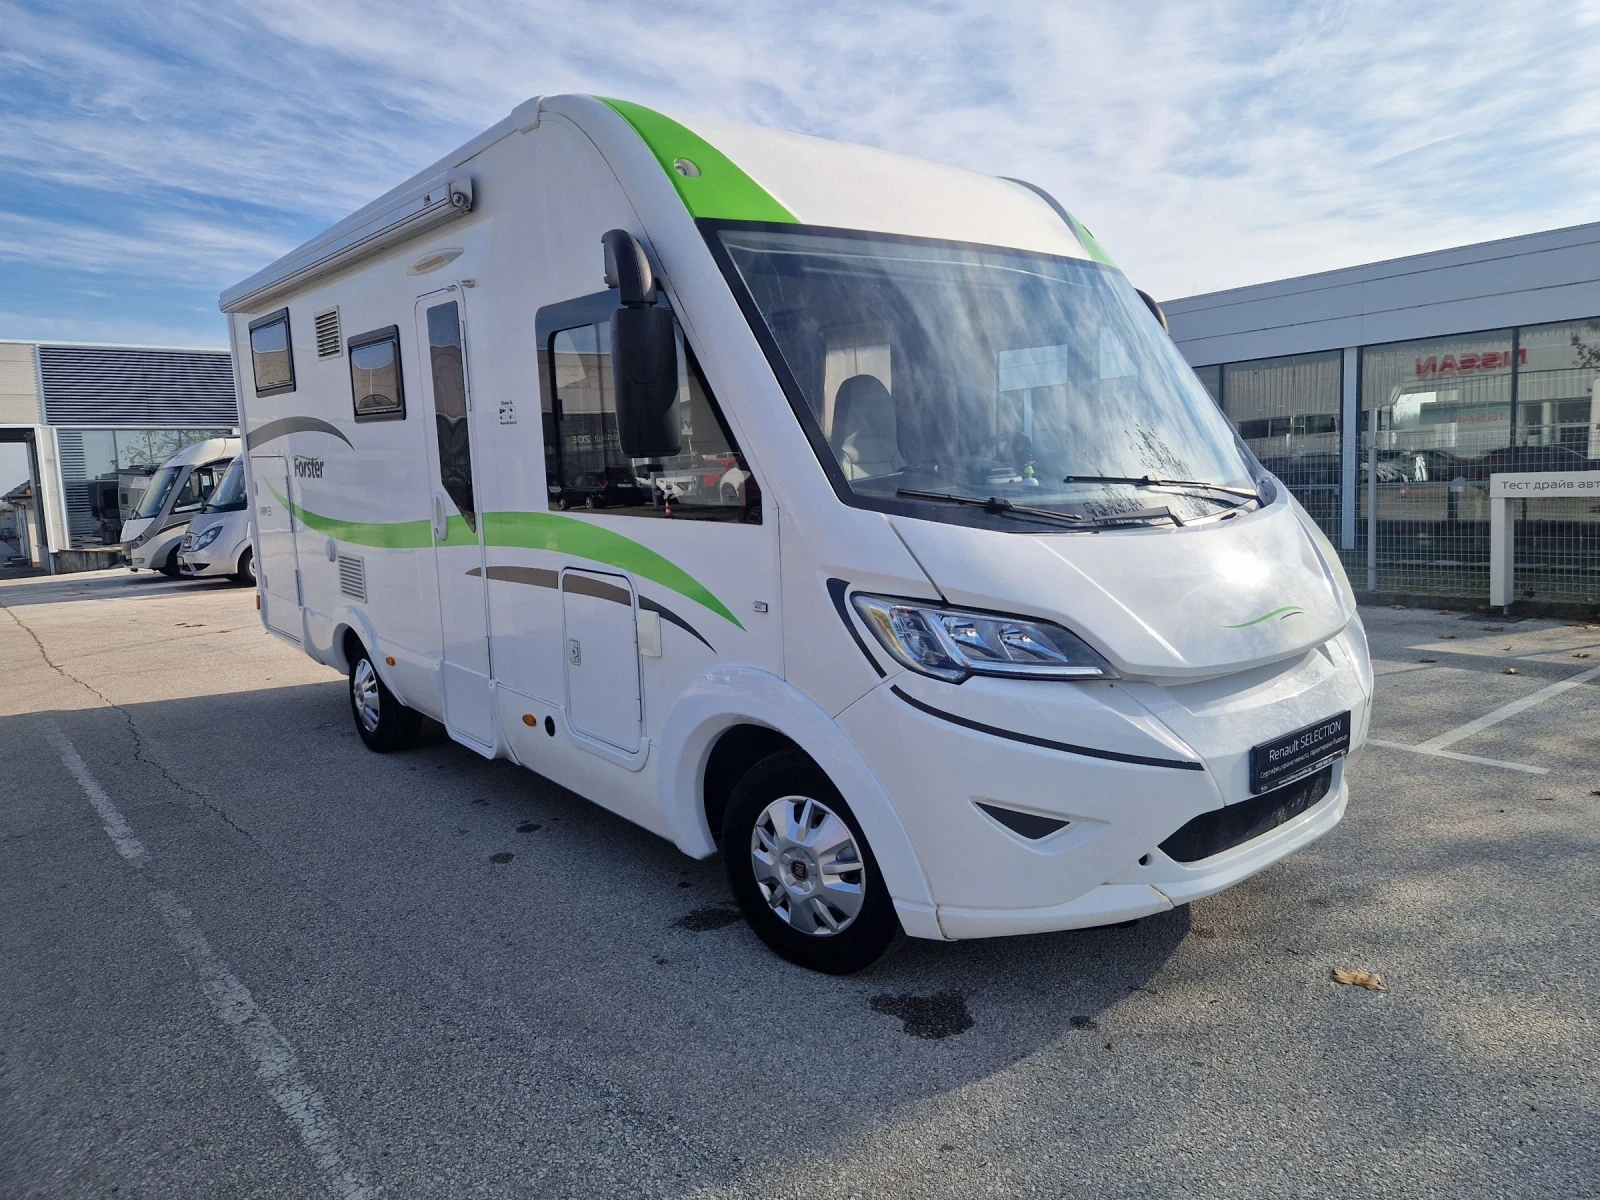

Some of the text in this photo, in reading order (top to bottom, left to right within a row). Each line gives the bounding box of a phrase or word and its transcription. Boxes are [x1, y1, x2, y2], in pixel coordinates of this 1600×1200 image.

[293, 457, 324, 479] Forster
[1501, 481, 1530, 490] Тест
[1533, 480, 1574, 491] драйв
[1269, 720, 1341, 762] Renault SELECTION
